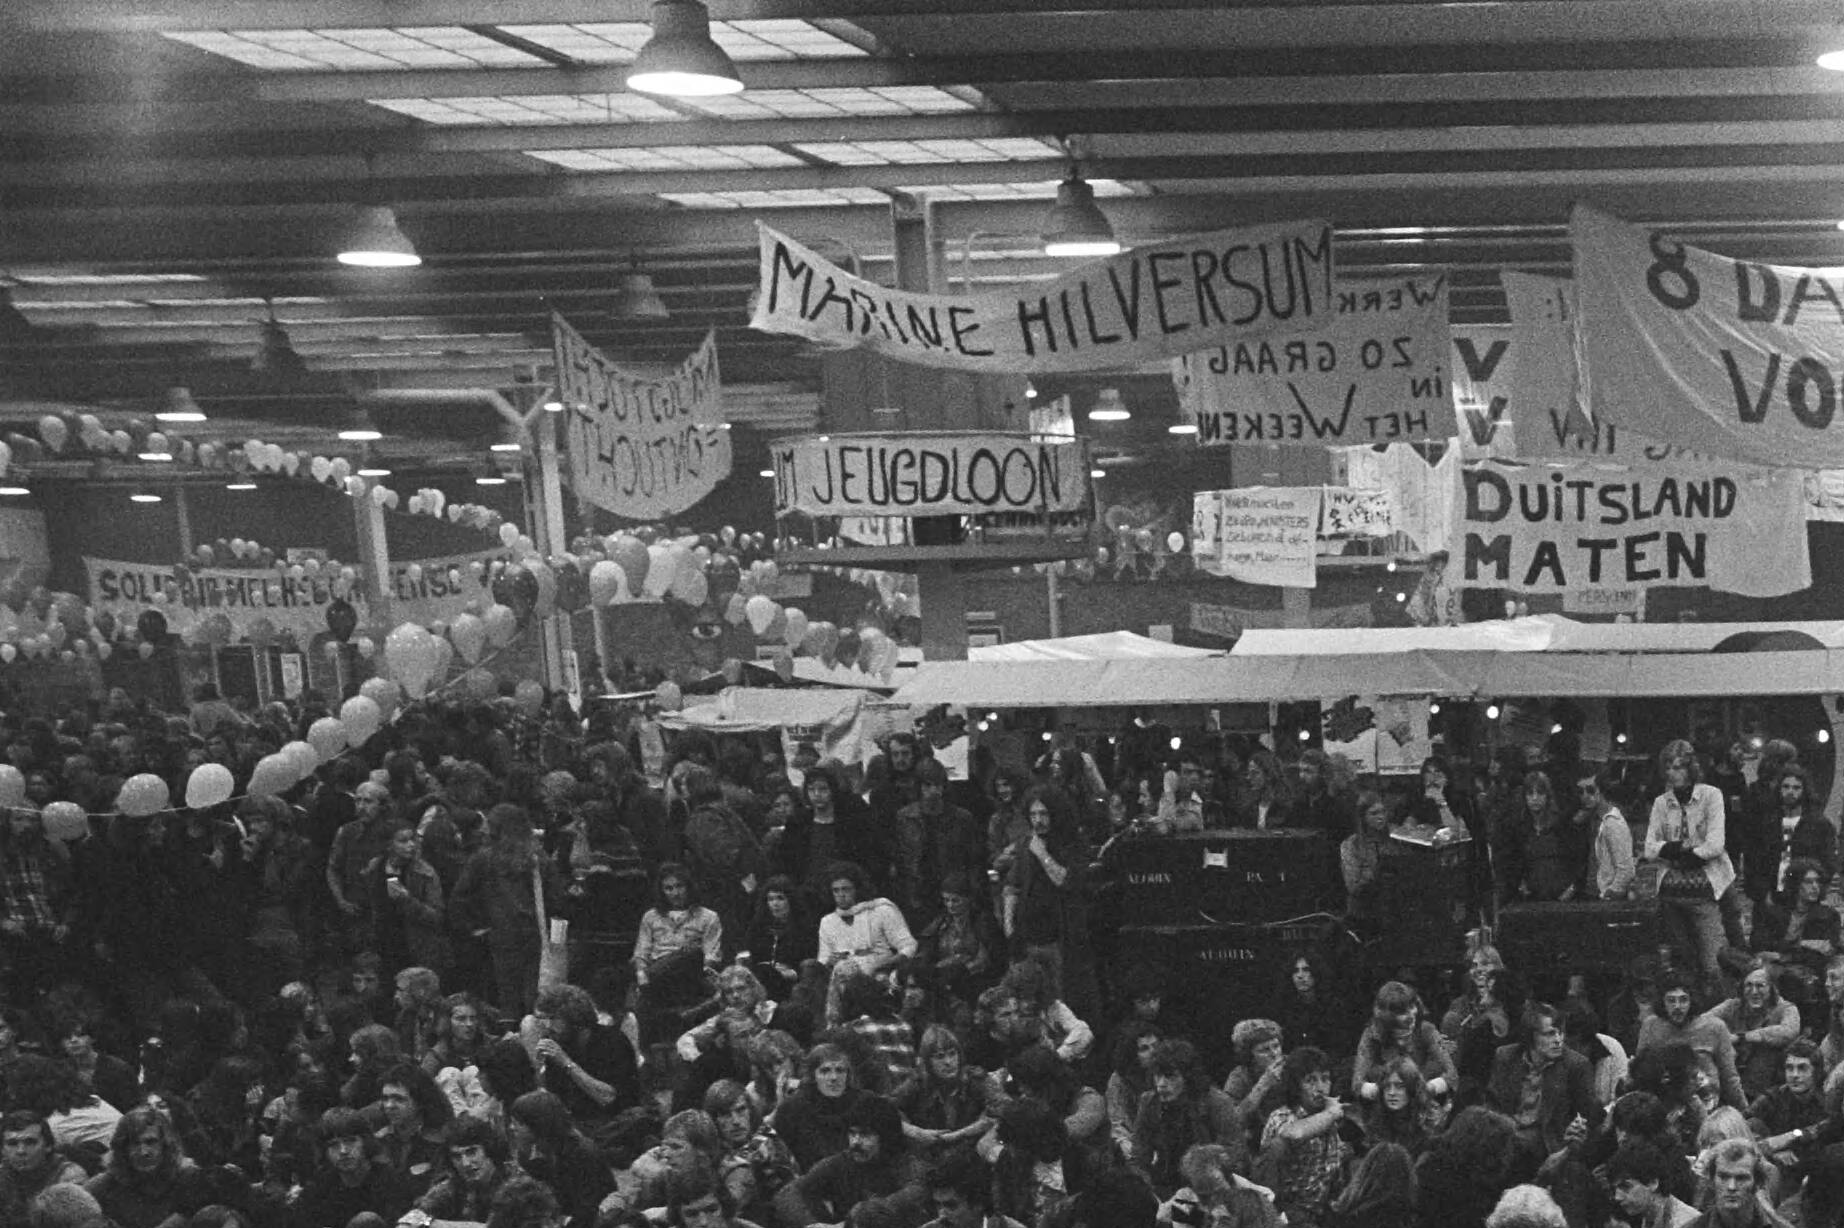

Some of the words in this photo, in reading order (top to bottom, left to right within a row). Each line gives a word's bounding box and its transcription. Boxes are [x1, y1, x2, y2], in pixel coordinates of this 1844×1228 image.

[769, 240, 994, 356] MARINE
[1017, 224, 1333, 356] HILVERSUM
[1646, 231, 1700, 310] 8
[812, 444, 1066, 506] JEUGDLOON
[1463, 530, 1708, 587] MATEN
